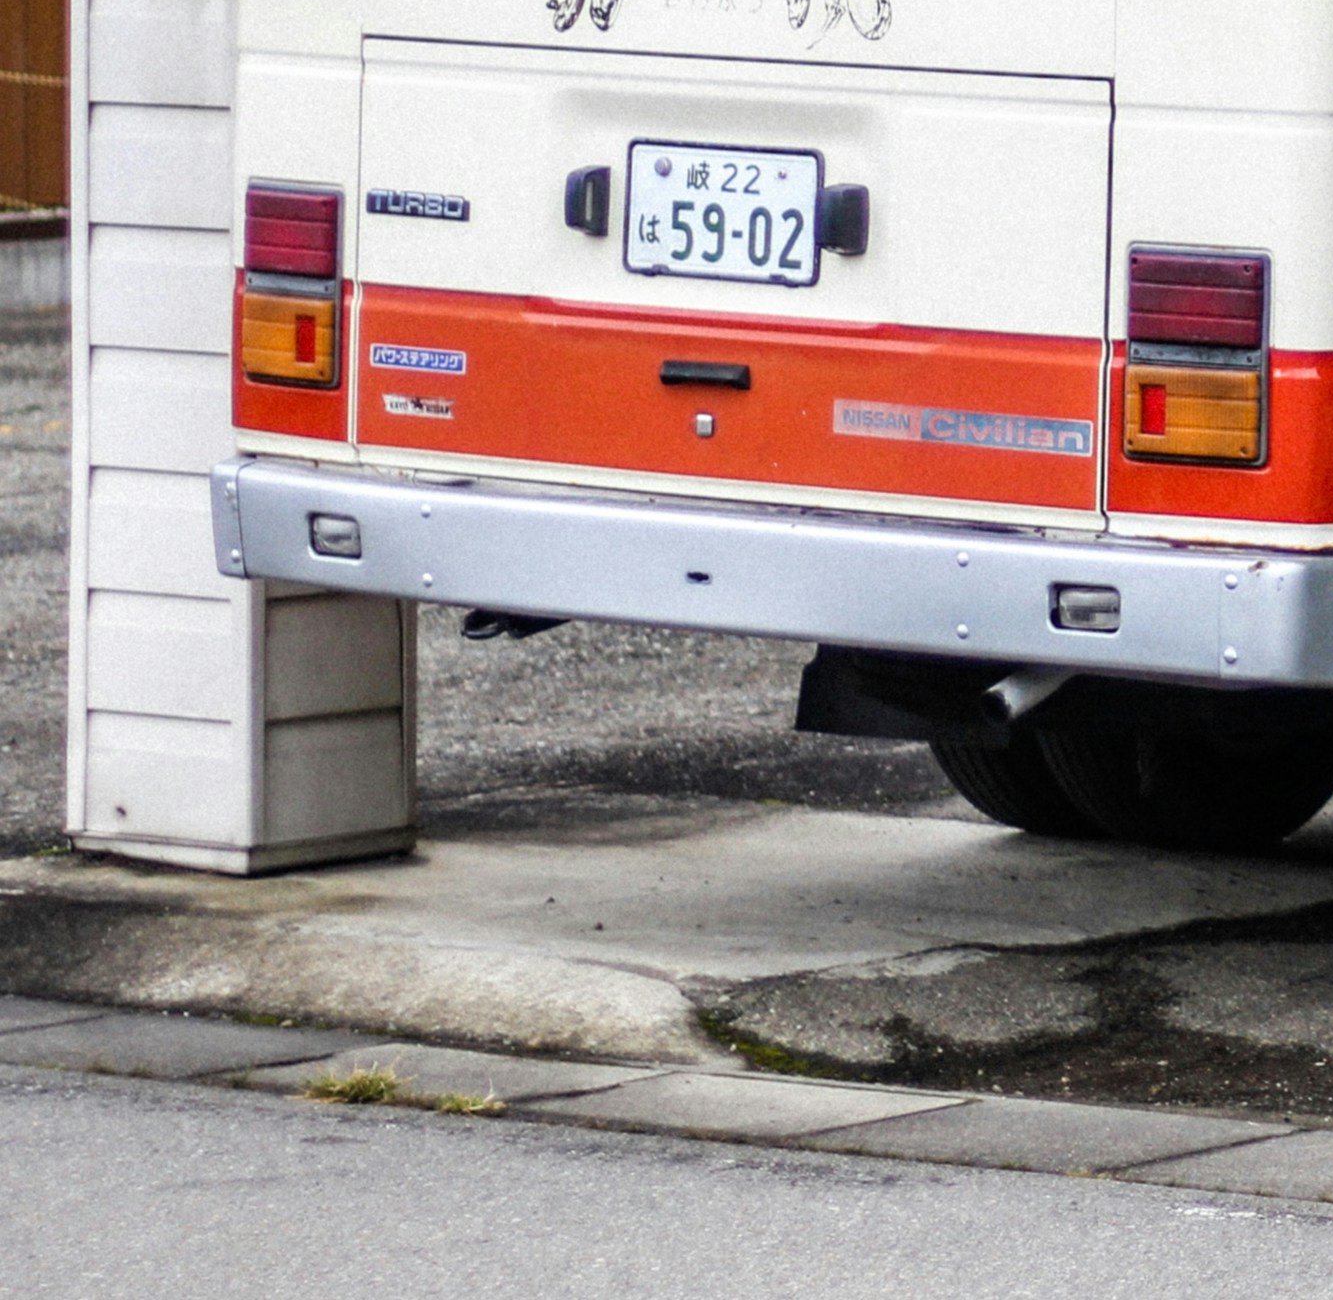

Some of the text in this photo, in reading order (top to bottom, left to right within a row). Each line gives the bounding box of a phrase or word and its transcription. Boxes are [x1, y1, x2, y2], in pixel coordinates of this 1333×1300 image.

[370, 189, 465, 218] TURBO
[842, 408, 1084, 450] NISSAN Civilian
